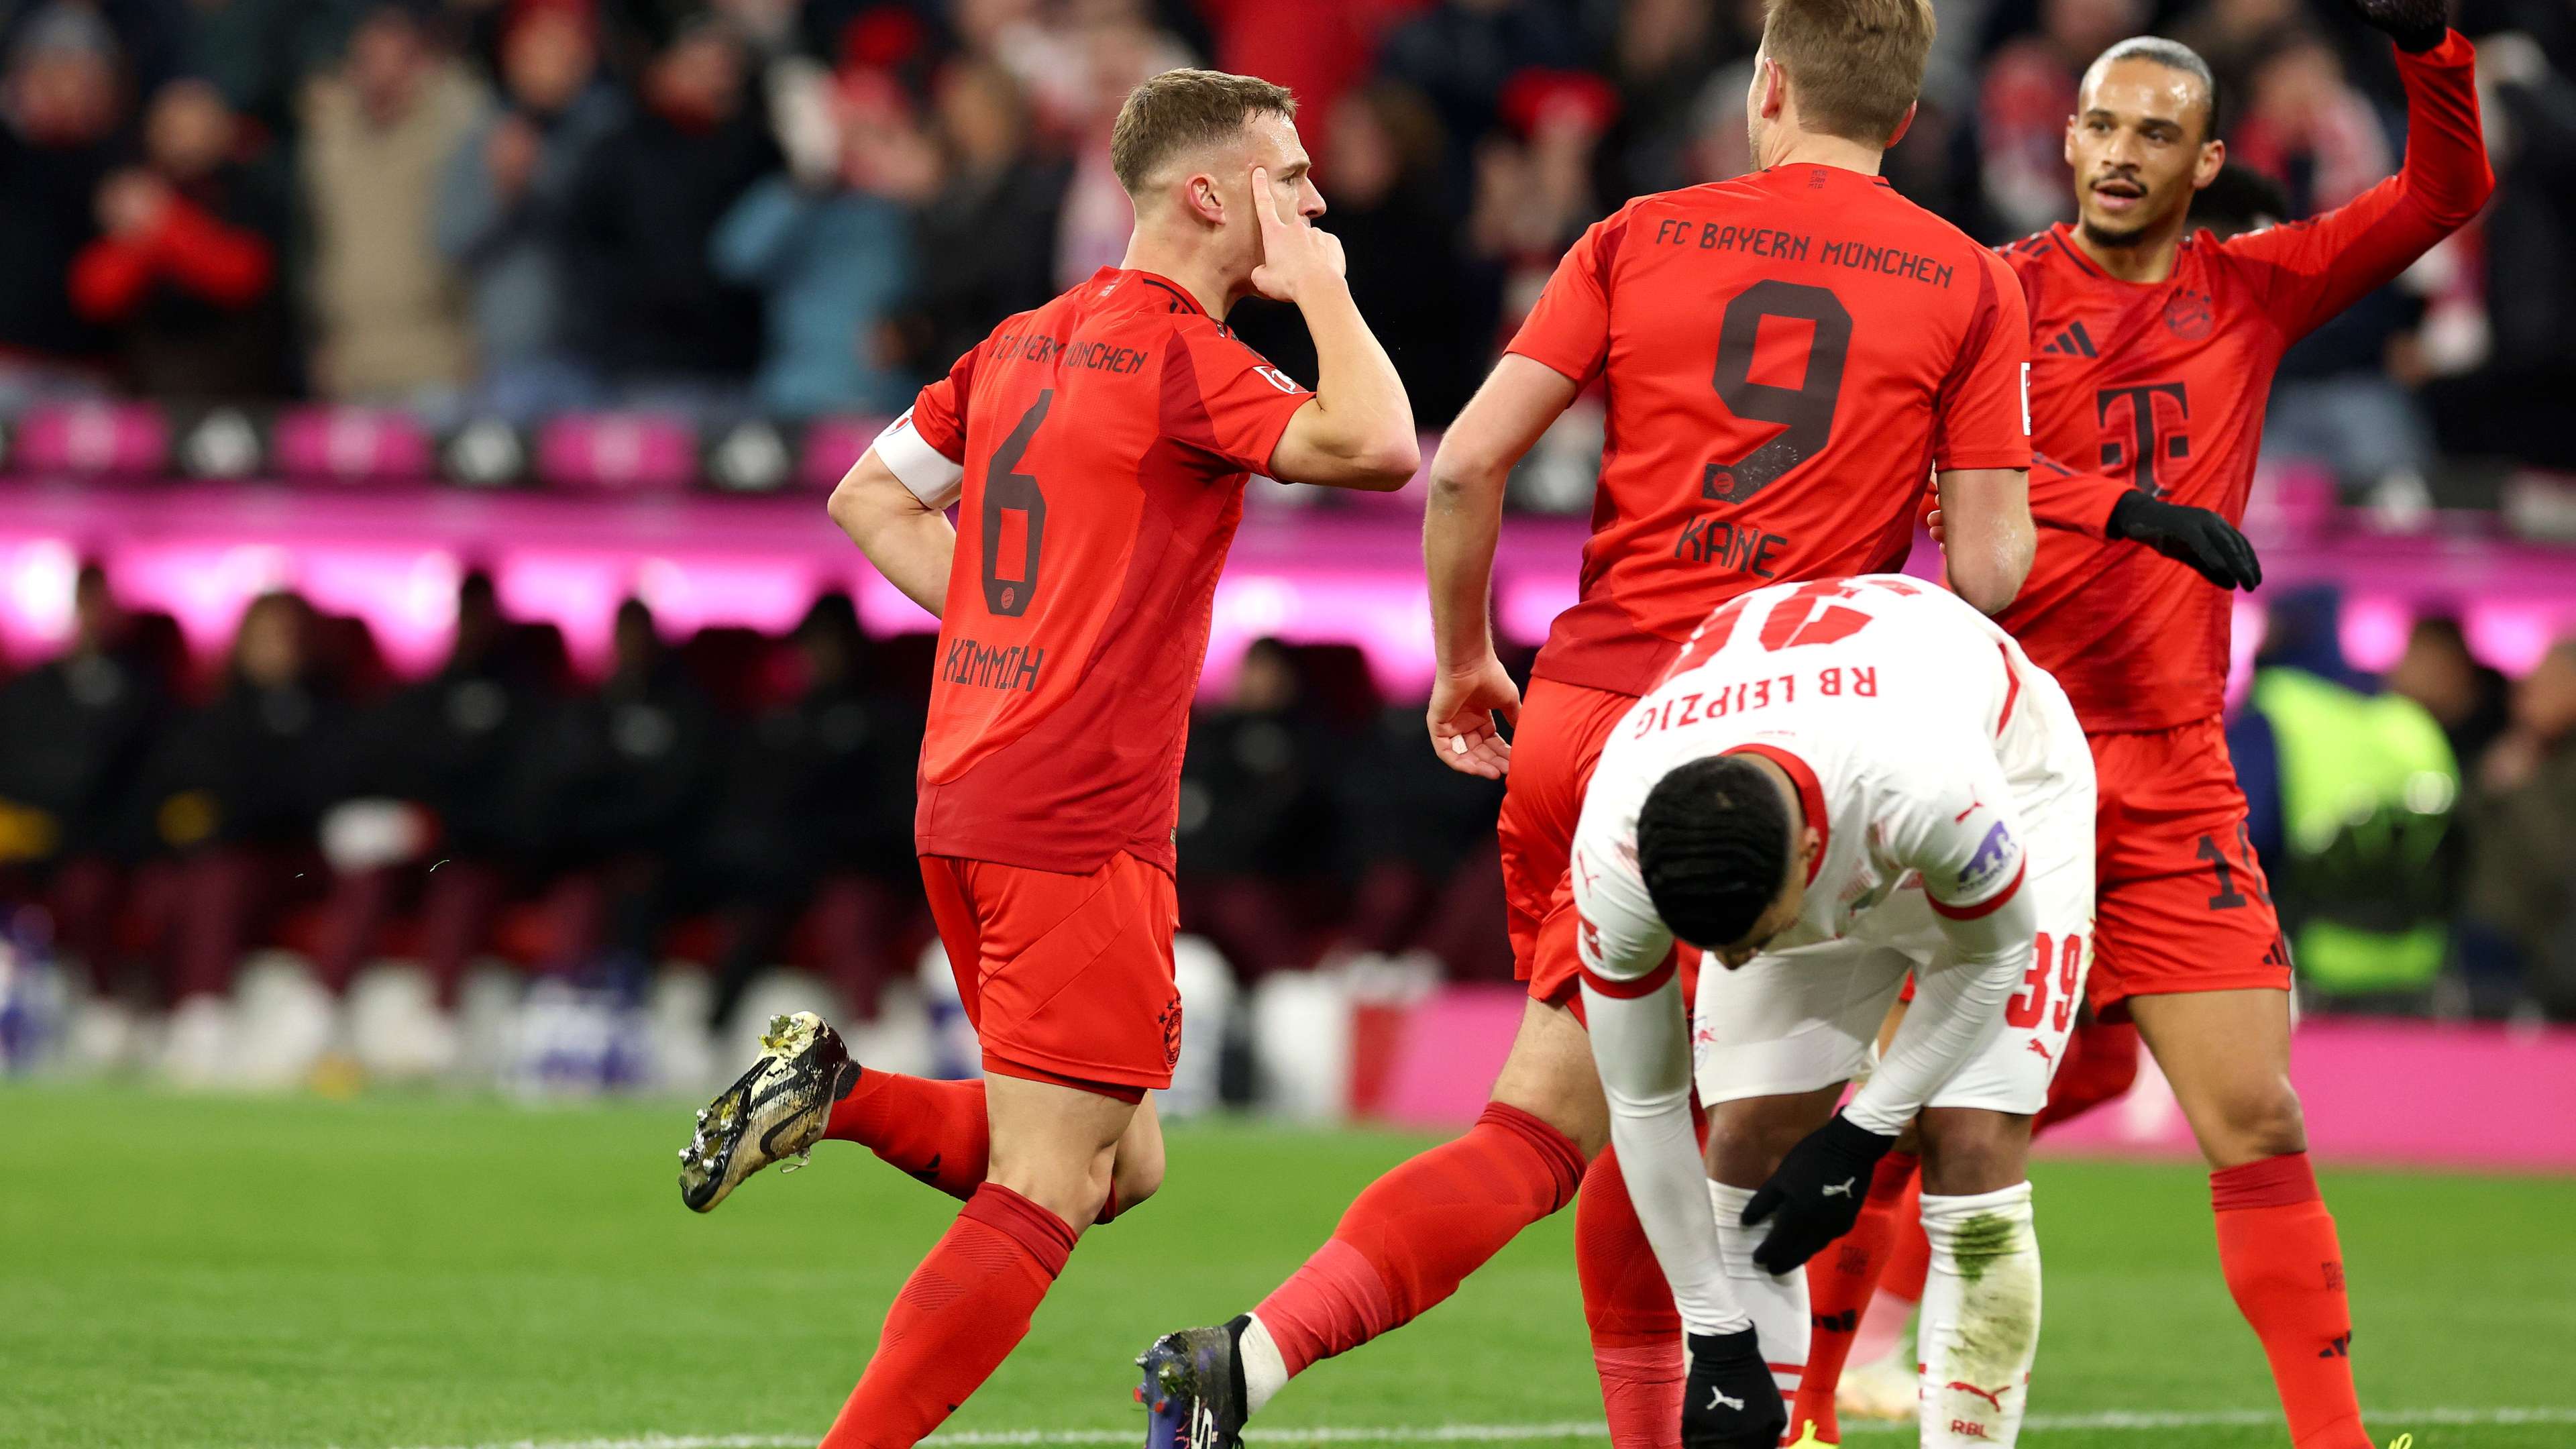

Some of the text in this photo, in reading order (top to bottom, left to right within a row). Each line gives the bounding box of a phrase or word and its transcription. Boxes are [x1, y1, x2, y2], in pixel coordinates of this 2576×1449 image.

[1656, 219, 1954, 290] FC BAYERN MÜNCHEN
[1702, 279, 1854, 505] 9
[981, 389, 1053, 616] 6
[1674, 515, 1788, 579] KANE
[943, 638, 1044, 692] KIMMIH
[1633, 666, 1878, 741] RB LEIPZIG
[2196, 822, 2273, 910] 1
[2004, 931, 2082, 1033] 39
[1951, 1419, 1988, 1438] RBL
